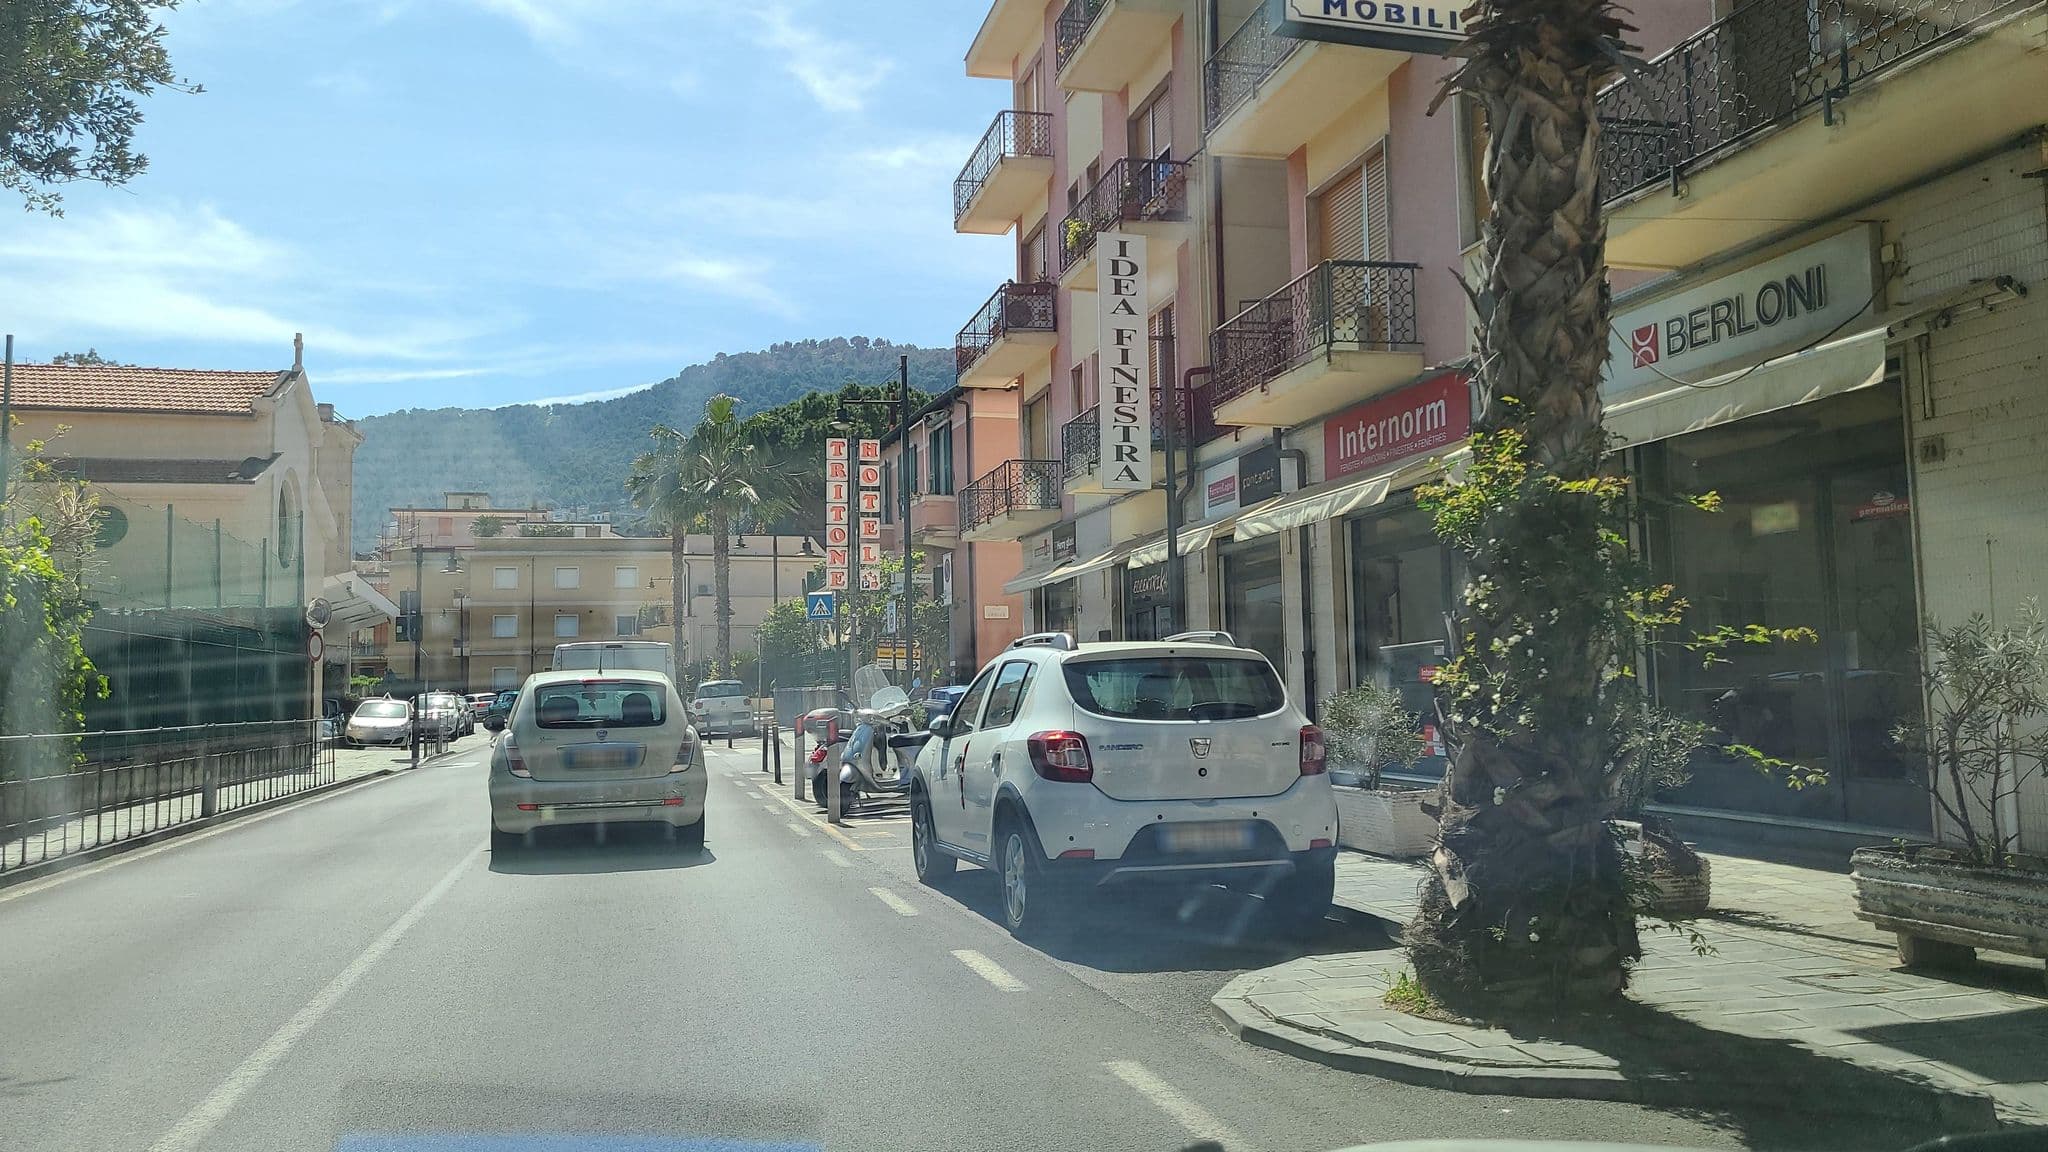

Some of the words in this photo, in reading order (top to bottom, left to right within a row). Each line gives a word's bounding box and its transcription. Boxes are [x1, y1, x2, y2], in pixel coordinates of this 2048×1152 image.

[1324, 0, 1457, 30] MOBILI
[1110, 240, 1139, 315] IDEA
[1666, 264, 1825, 358] BERLONI
[1110, 328, 1141, 482] FINESTRA
[1339, 399, 1446, 460] Internorm
[829, 441, 846, 587] TRITONE
[862, 442, 878, 562] HOTEL
